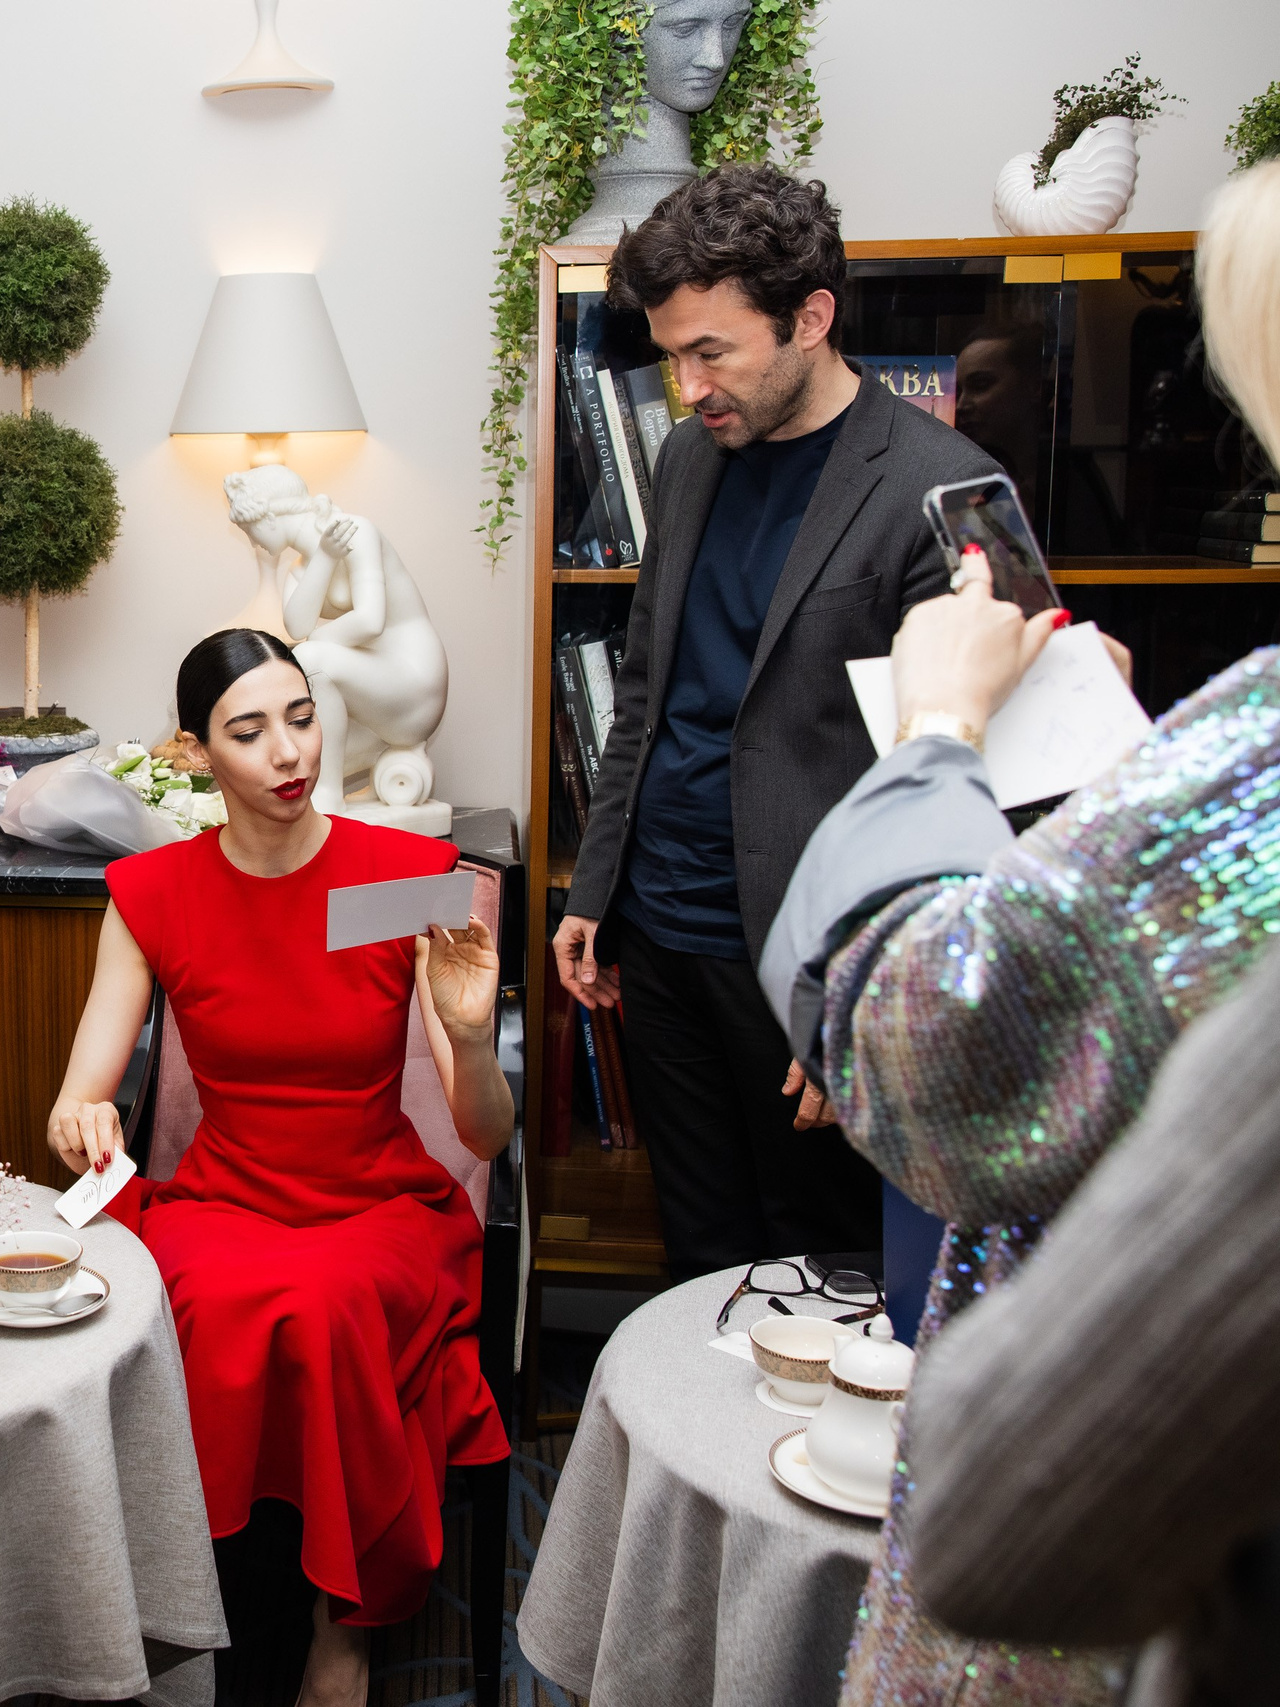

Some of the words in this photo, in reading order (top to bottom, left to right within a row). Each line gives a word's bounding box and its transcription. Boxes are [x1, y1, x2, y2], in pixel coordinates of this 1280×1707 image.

[586, 388, 595, 396] A
[589, 402, 615, 482] PORTFOLIO
[644, 410, 658, 446] Серов
[589, 757, 599, 773] ABC
[584, 1023, 595, 1056] MOSCOW
